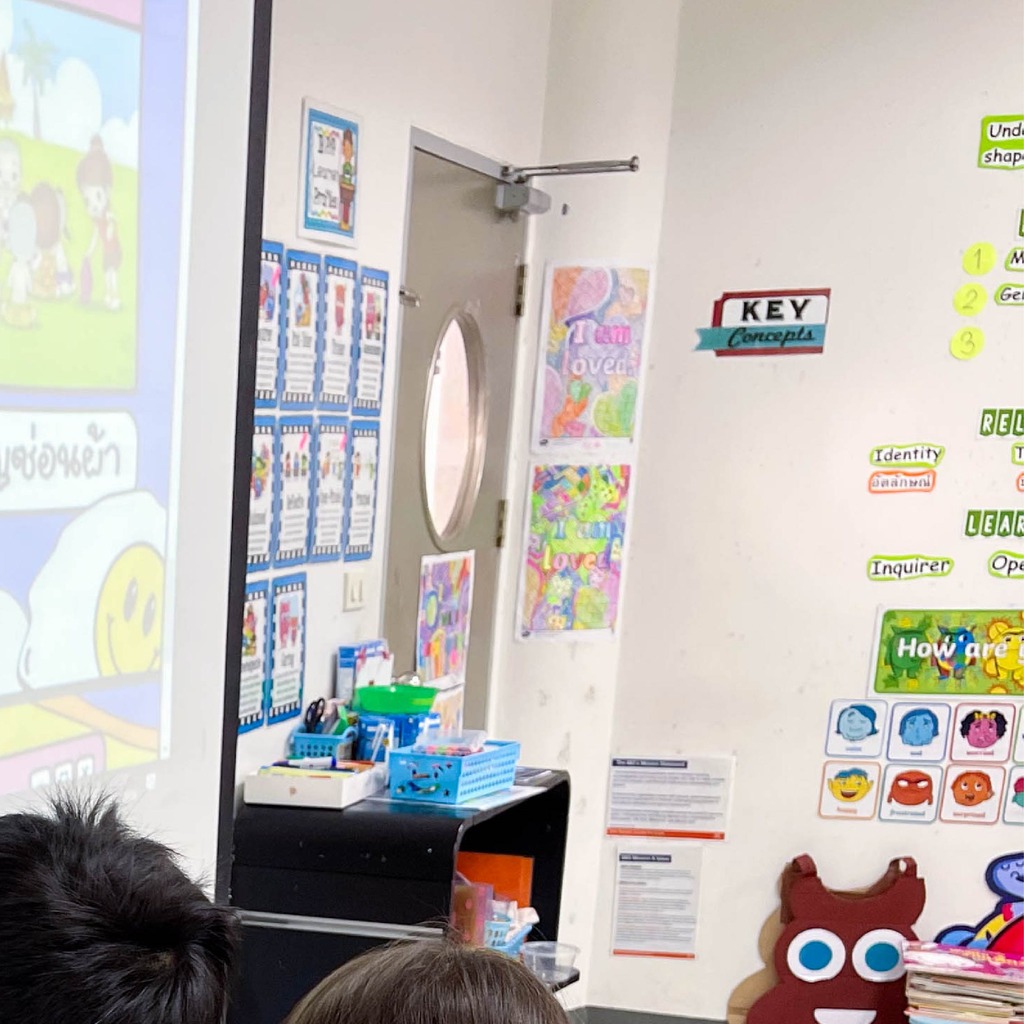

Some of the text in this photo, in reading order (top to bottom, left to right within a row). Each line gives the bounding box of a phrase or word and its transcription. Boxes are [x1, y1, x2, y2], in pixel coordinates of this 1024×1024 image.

[962, 288, 978, 309] 2
[741, 299, 812, 322] KEY
[728, 325, 816, 348] Concepts
[960, 331, 975, 356] 3
[982, 413, 1024, 433] REL
[874, 446, 942, 463] Identity
[871, 558, 951, 580] Inquirer
[897, 638, 957, 659] How
[965, 642, 1008, 659] are
